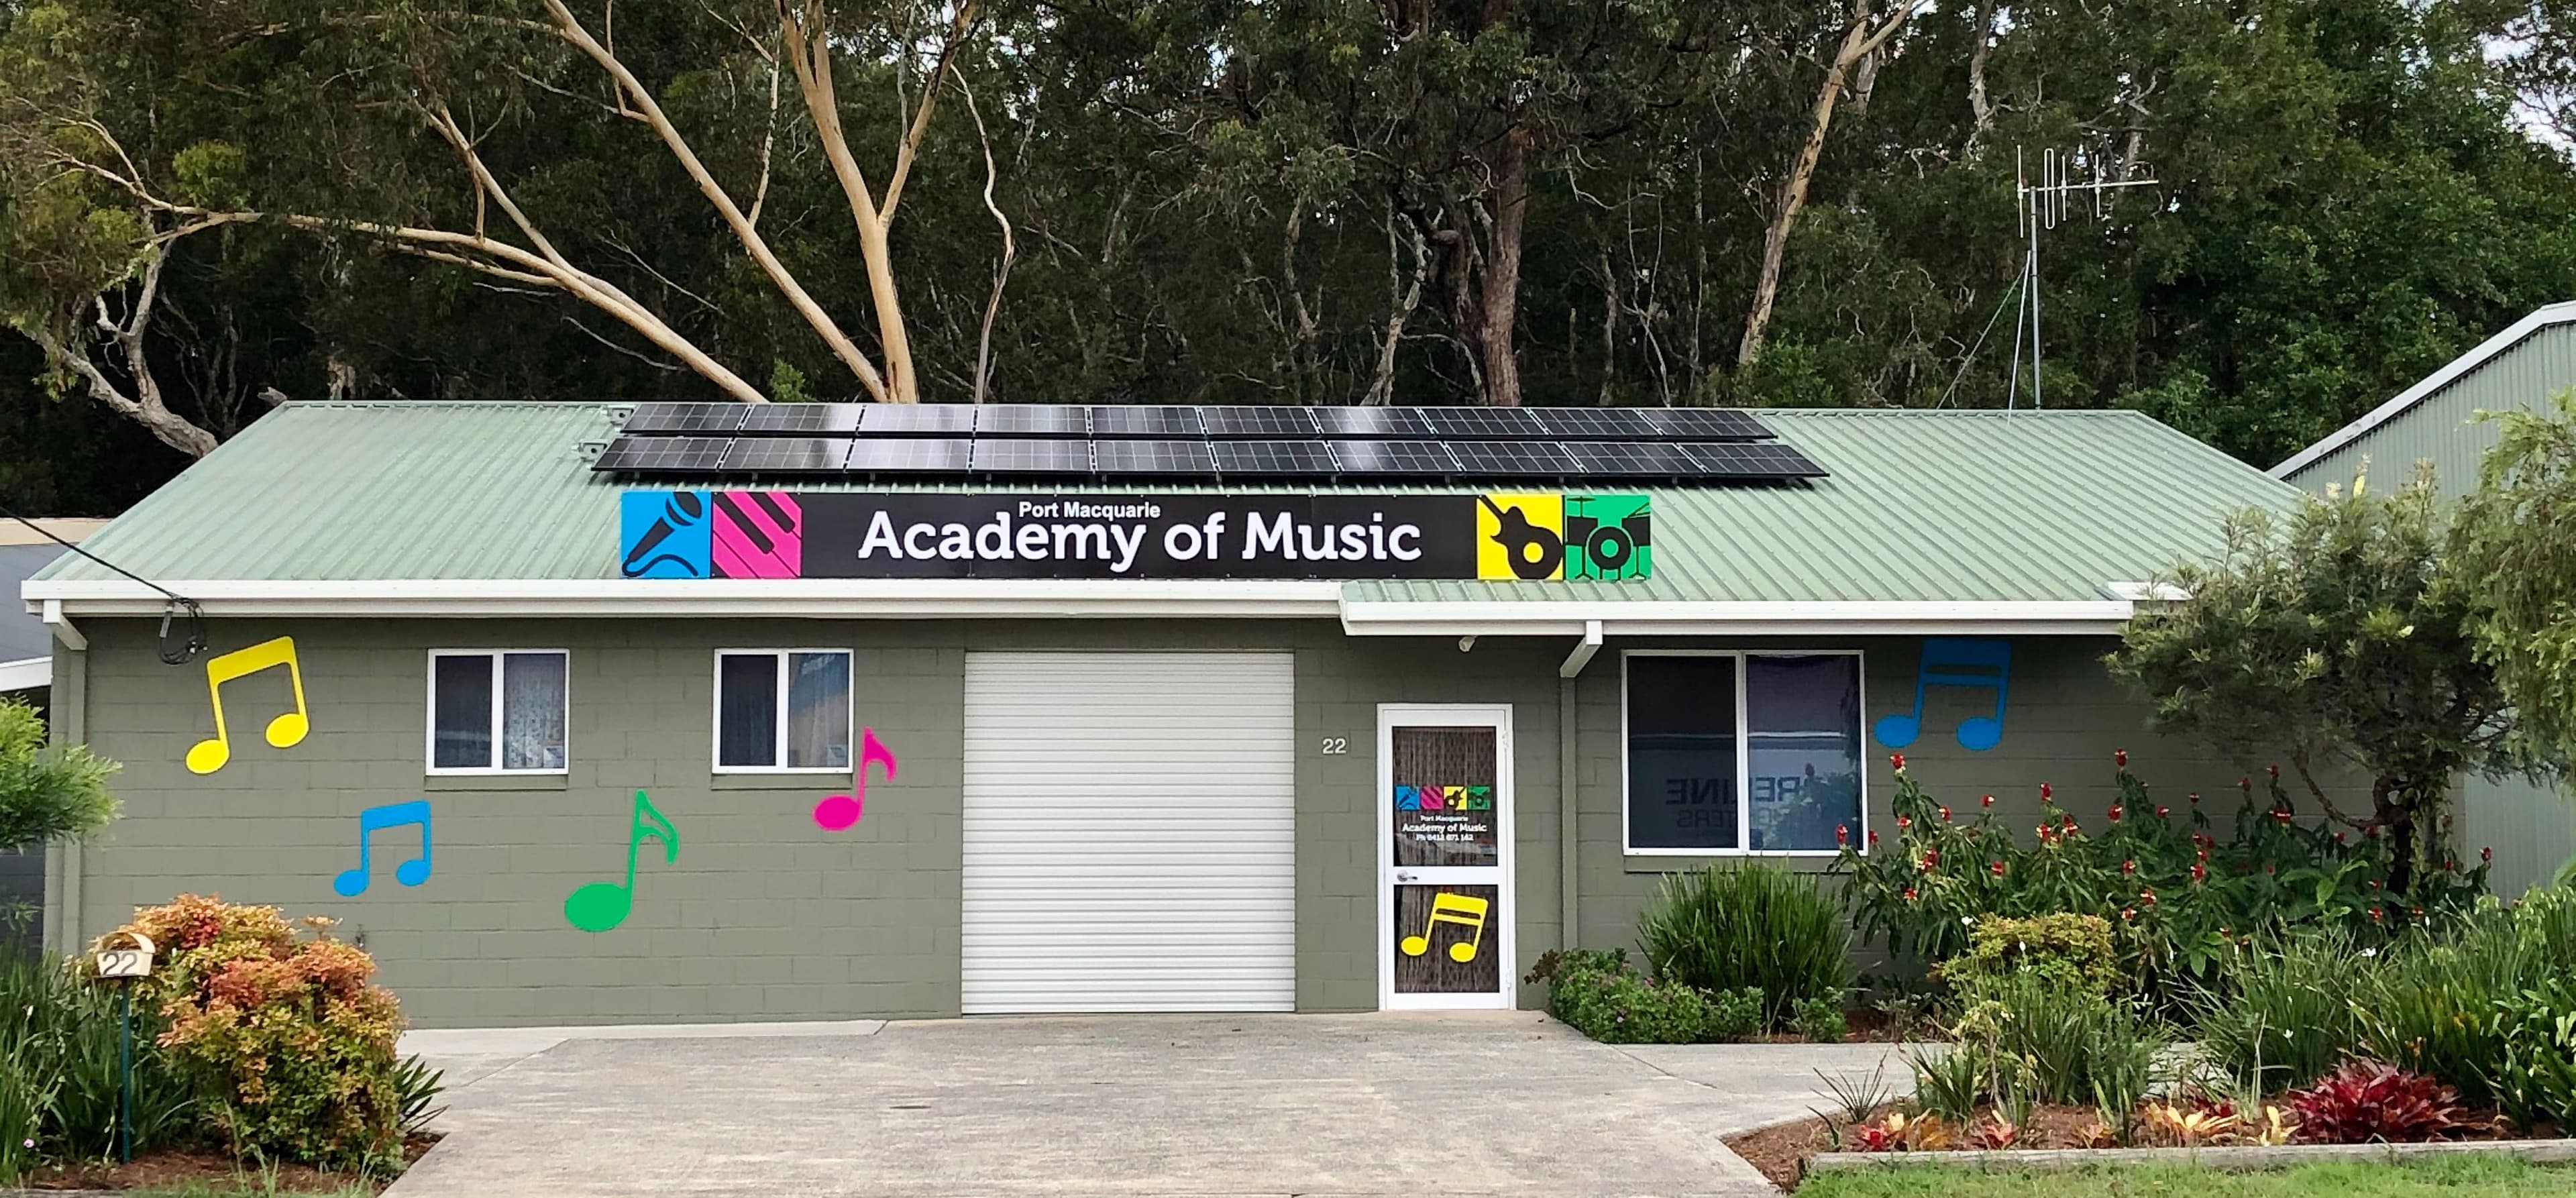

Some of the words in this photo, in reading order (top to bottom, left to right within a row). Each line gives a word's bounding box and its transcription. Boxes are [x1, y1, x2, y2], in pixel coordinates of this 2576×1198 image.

[1018, 501, 1059, 518] Port
[1063, 501, 1161, 521] Macquarie
[857, 510, 1147, 573] Academy
[1164, 511, 1226, 560] of
[1242, 511, 1422, 561] Music
[1322, 737, 1347, 754] 22
[1402, 823, 1446, 834] Academy
[1447, 823, 1458, 832] of
[1459, 823, 1487, 832] Music
[101, 952, 138, 977] 22
